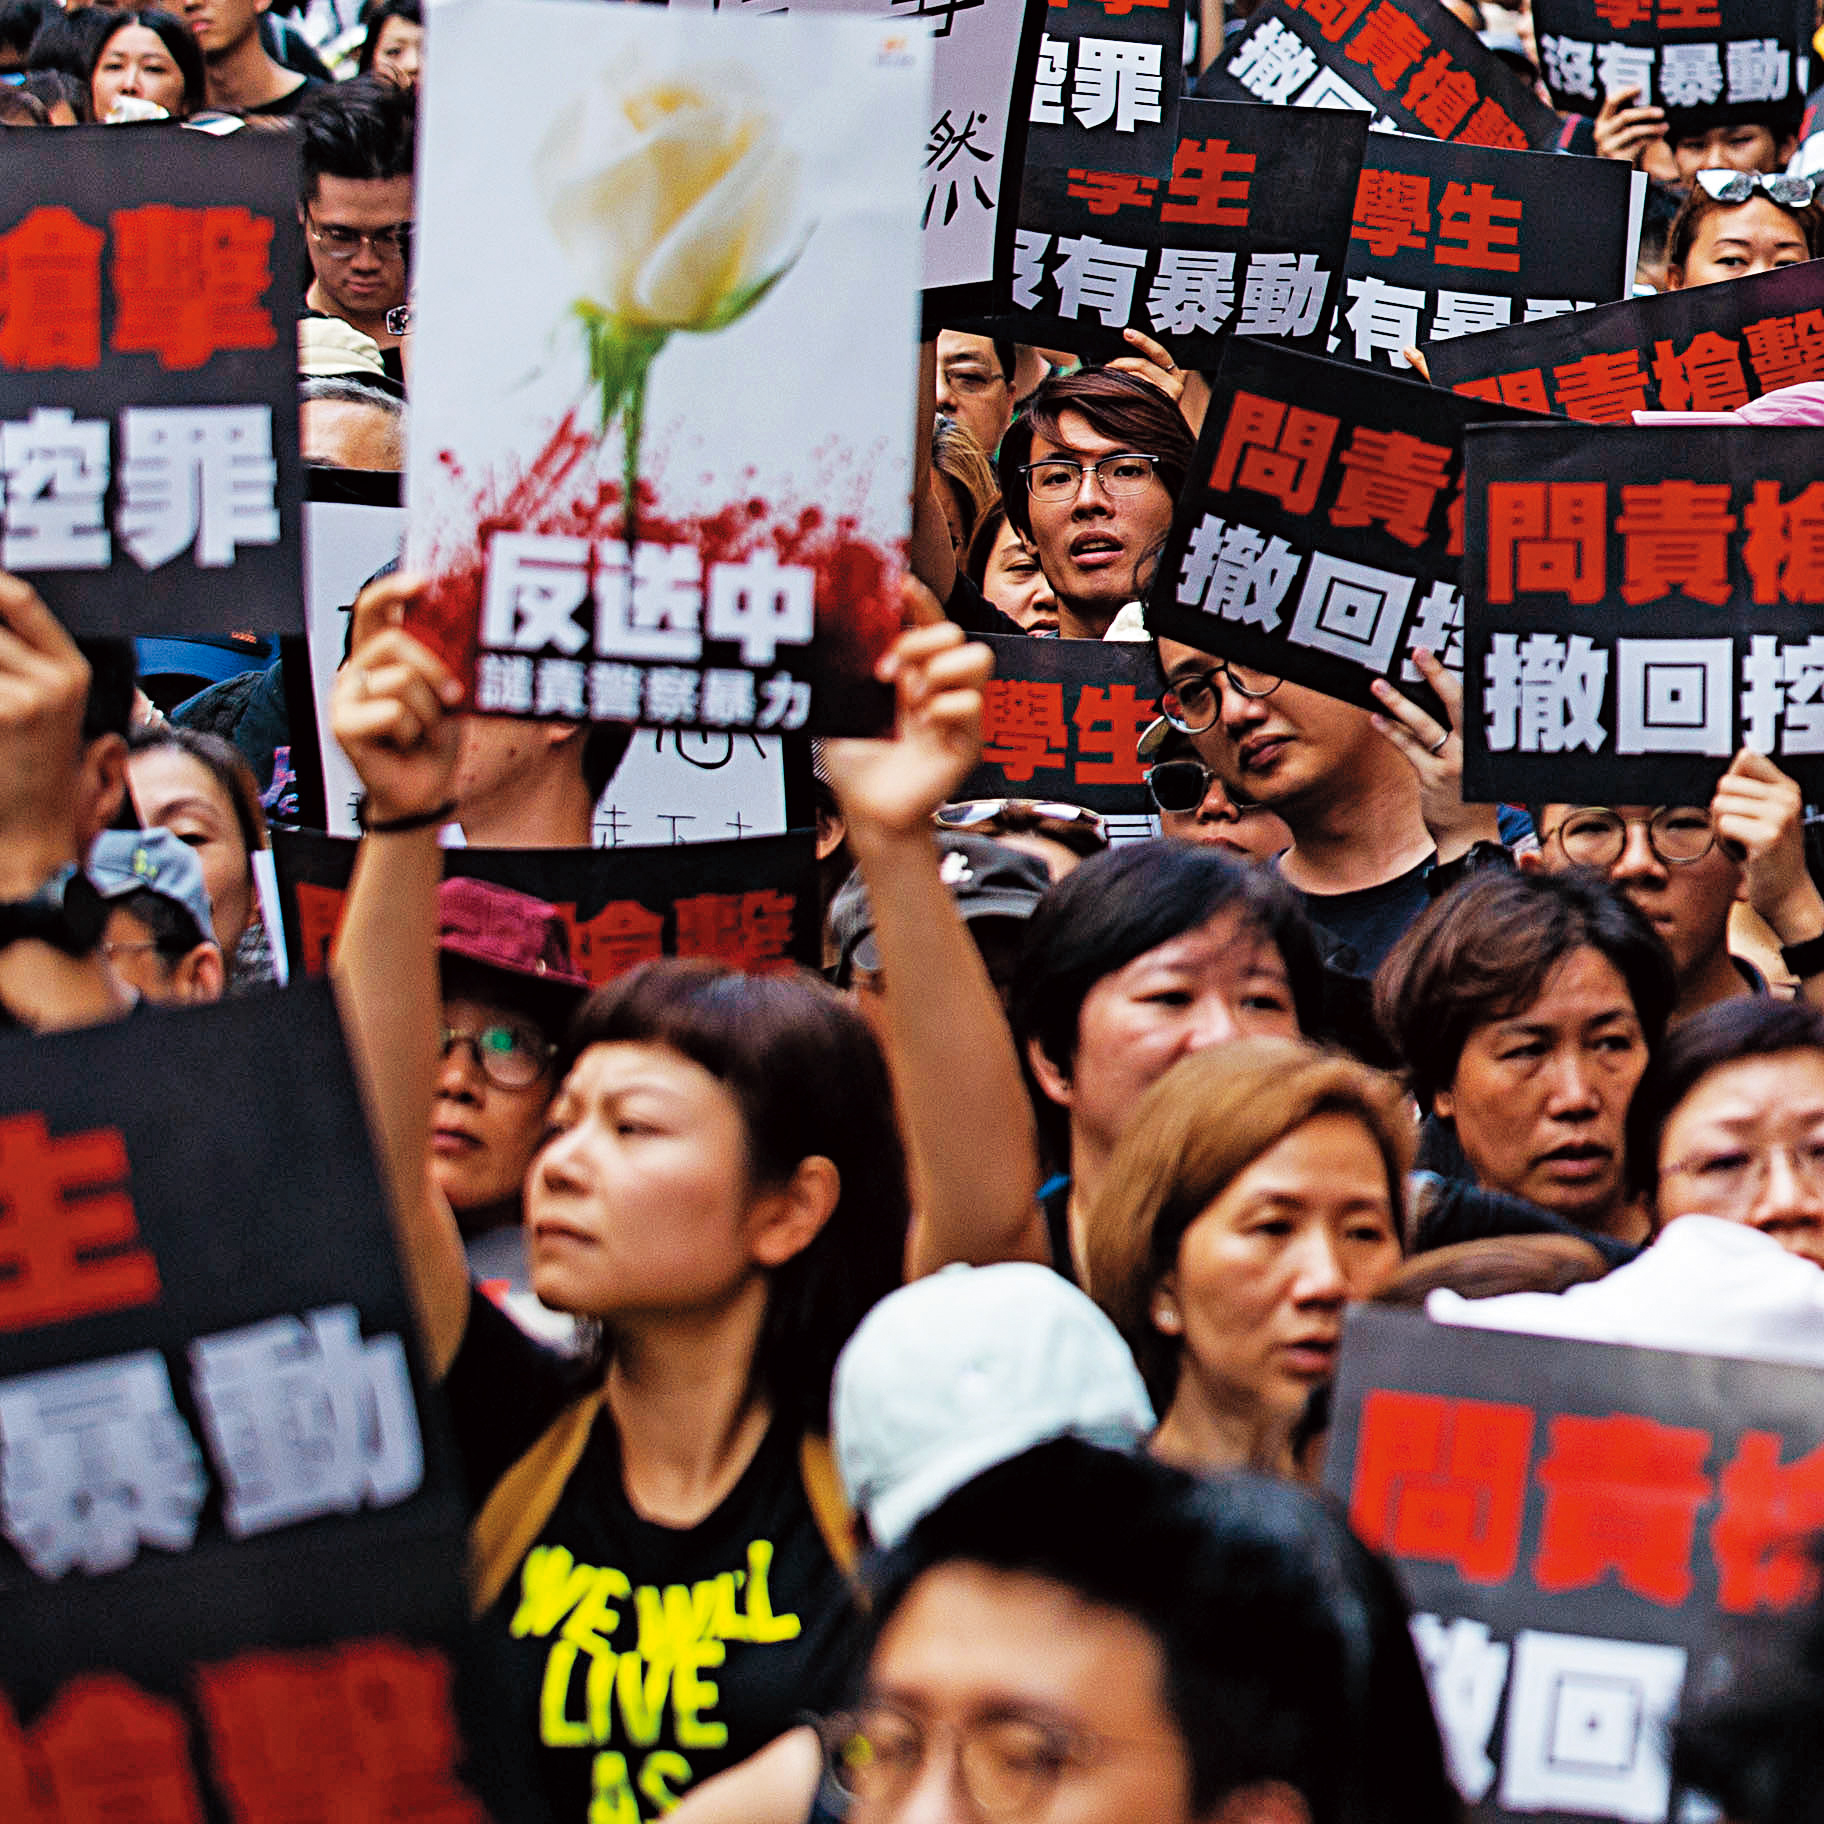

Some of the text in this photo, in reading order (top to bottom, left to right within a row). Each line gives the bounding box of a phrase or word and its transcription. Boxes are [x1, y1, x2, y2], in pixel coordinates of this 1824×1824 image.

[1541, 31, 1790, 108] 沒有暴動
[1208, 389, 1465, 558] 問責
[480, 529, 816, 667] 反送中
[509, 1544, 632, 1657] WE
[540, 1637, 729, 1750] LIVE
